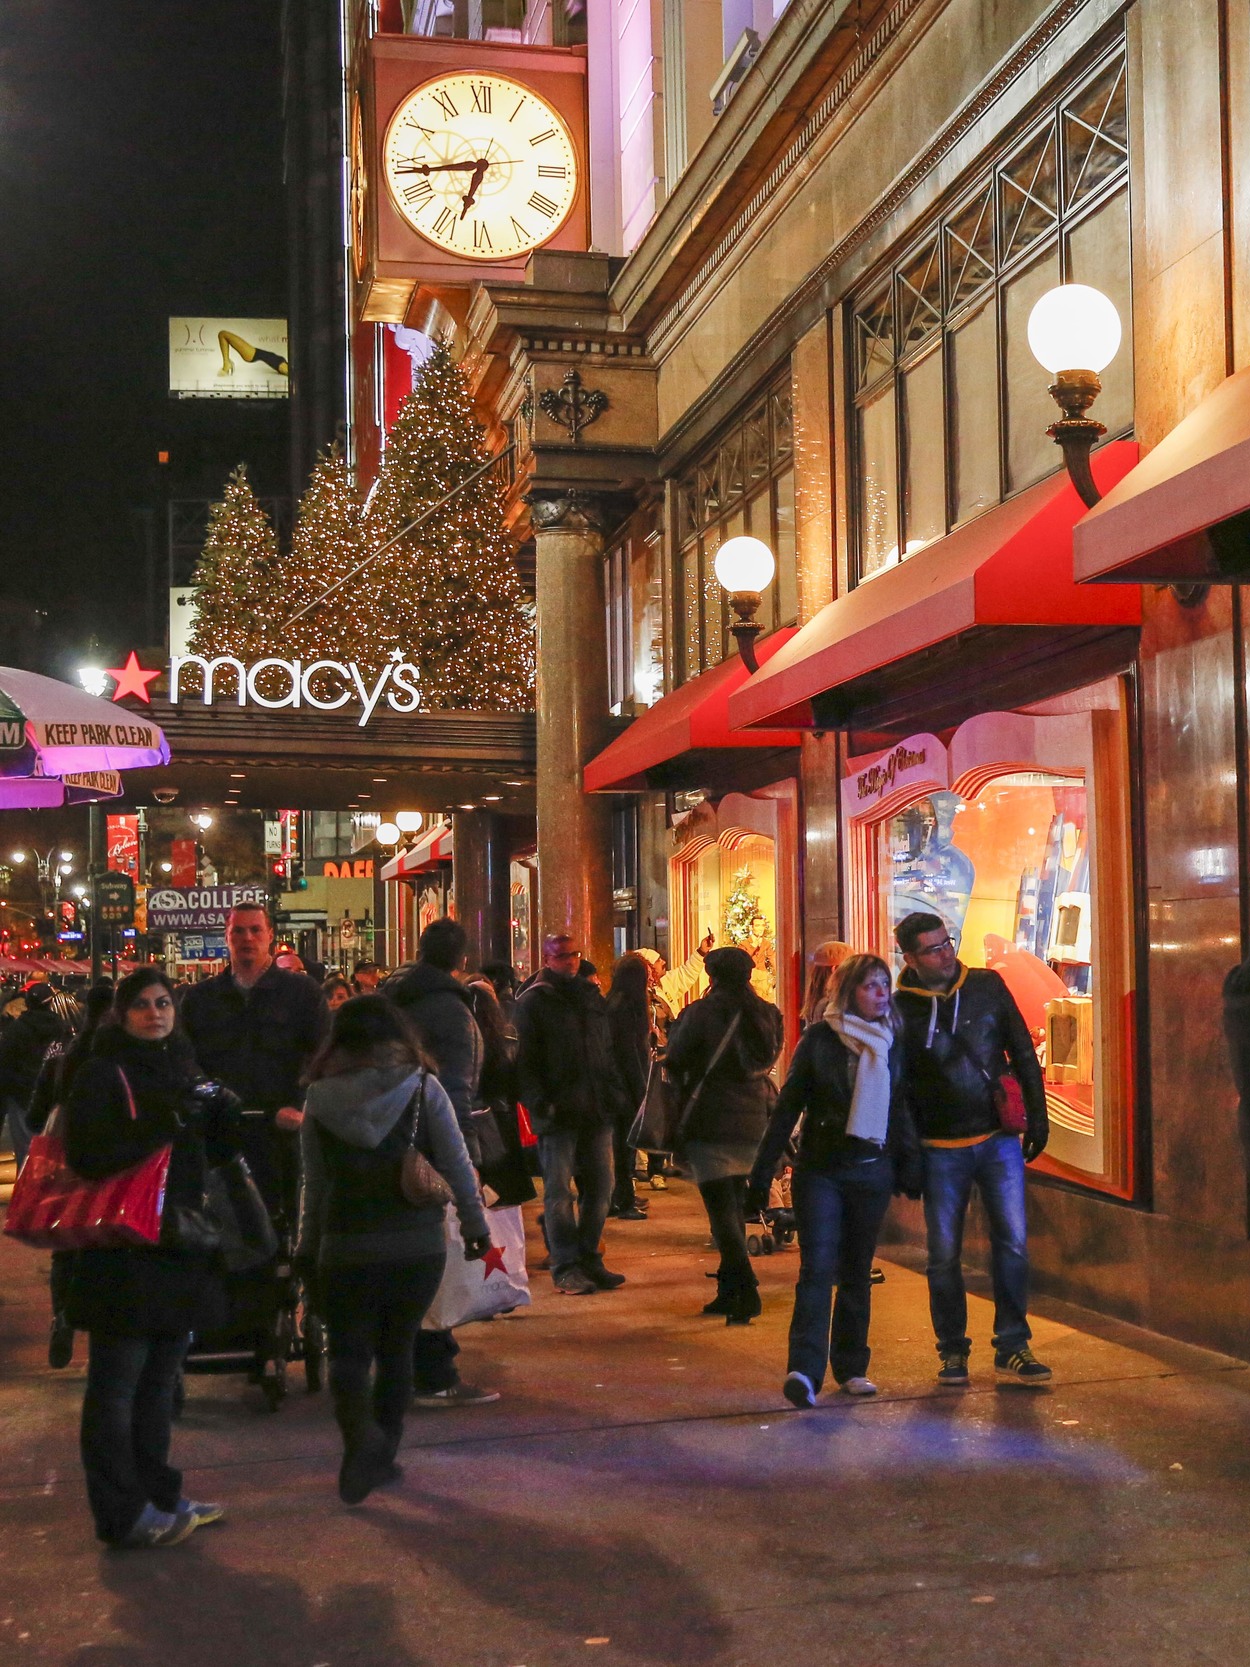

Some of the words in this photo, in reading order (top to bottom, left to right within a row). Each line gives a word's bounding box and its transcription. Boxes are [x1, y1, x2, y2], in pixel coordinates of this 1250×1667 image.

[470, 85, 492, 114] XII
[170, 646, 421, 727] macy's
[45, 723, 78, 746] KEEP
[81, 723, 113, 746] PARK
[115, 726, 153, 747] CLEAN
[65, 771, 82, 785] KEEP
[83, 771, 98, 788] PARK
[99, 772, 117, 793] CLEAN
[268, 826, 278, 837] NO
[266, 840, 281, 849] TURNS
[188, 890, 265, 909] COLLEGE
